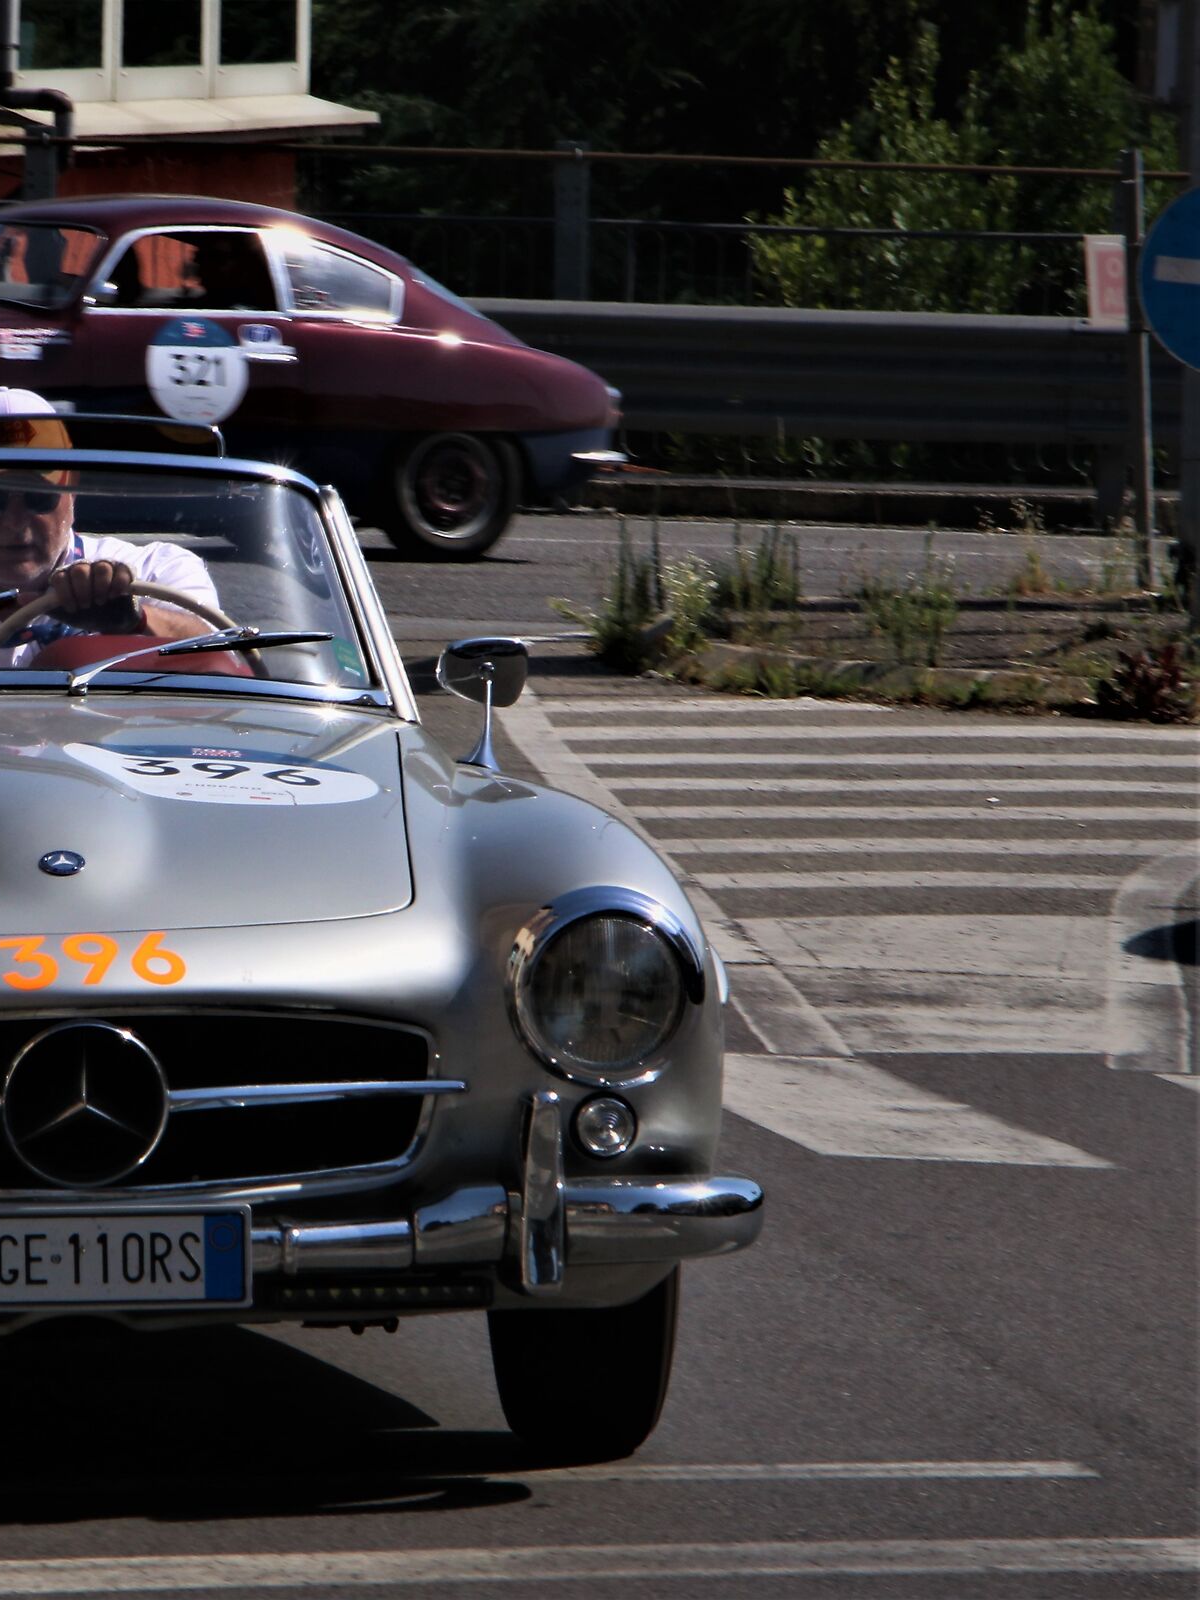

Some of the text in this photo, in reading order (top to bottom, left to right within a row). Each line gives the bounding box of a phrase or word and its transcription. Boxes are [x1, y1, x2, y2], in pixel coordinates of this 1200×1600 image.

[169, 354, 227, 387] 321
[122, 757, 321, 786] 396
[68, 1231, 202, 1285] 110RS
